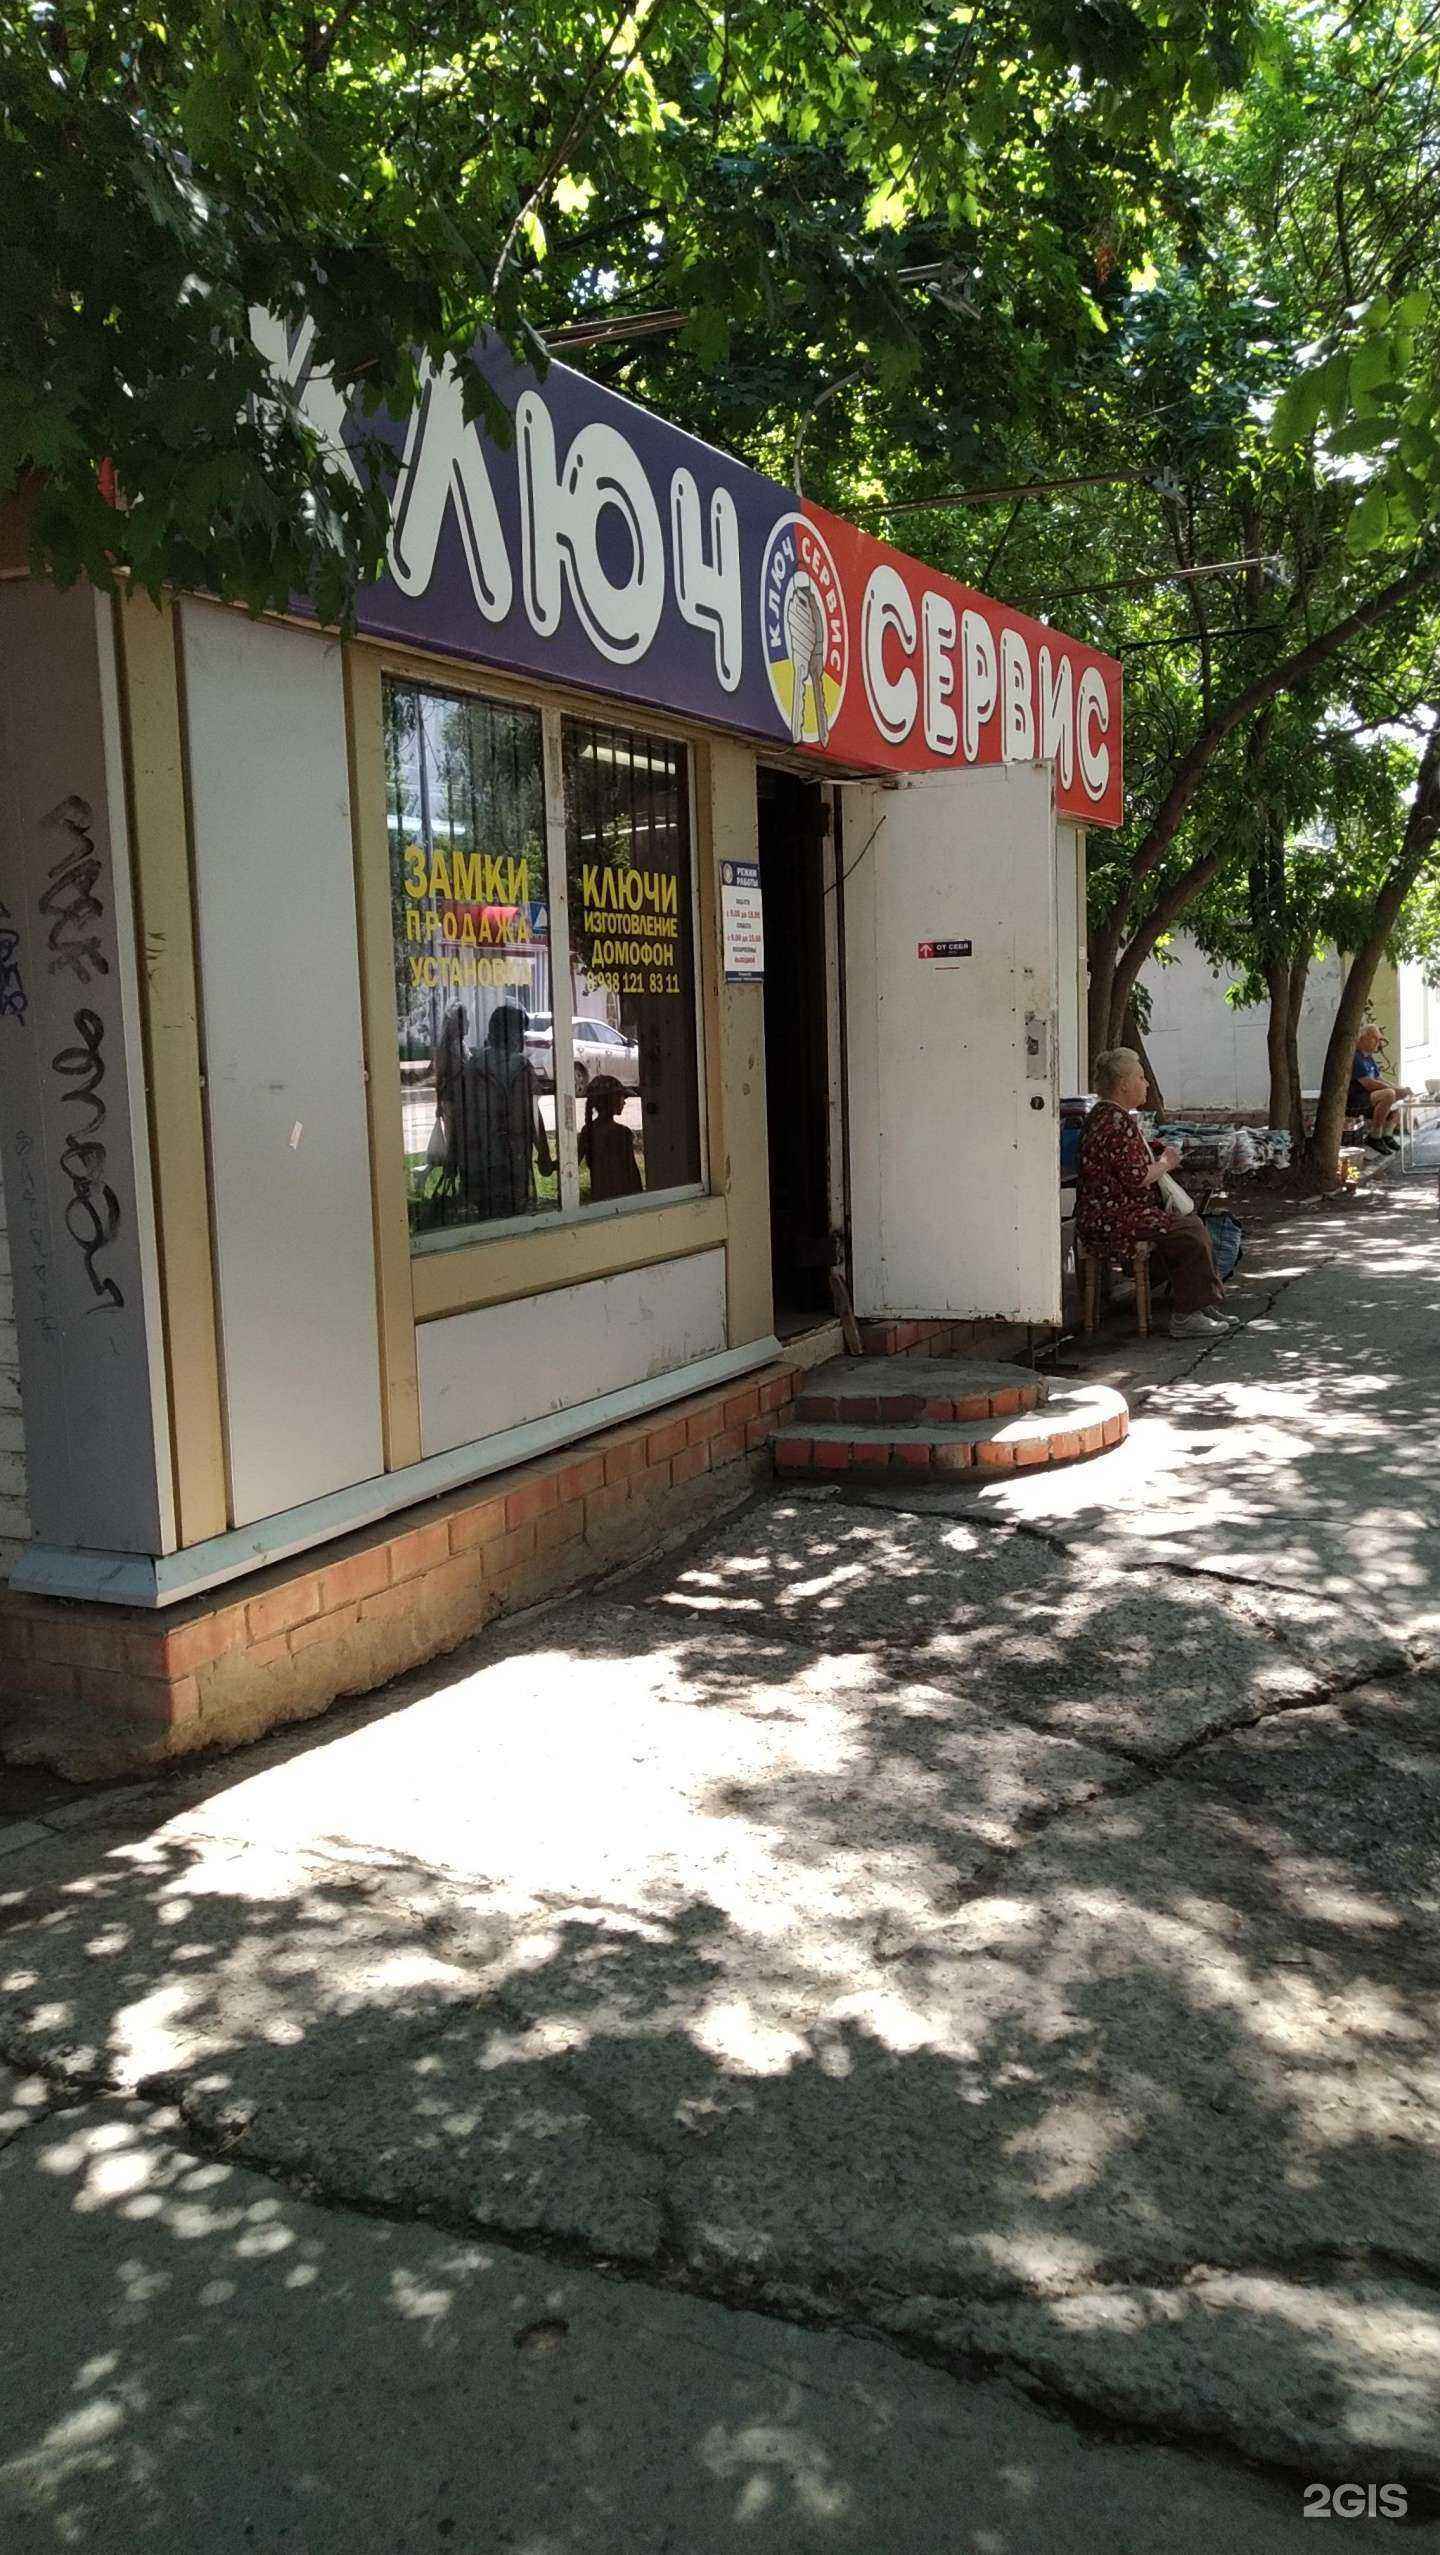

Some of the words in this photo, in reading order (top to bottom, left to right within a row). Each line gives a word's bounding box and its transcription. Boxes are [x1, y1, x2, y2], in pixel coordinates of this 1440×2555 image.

[767, 536, 796, 648] КЛЮЧ
[801, 537, 842, 672] СЕРВИС
[861, 565, 1109, 801] СЕРВИС
[404, 845, 529, 903] ЗАМКИ
[583, 864, 677, 914] КЛЮЧИ
[406, 909, 531, 948] ПРОДАЖА
[584, 910, 678, 938] ИЗГОТОВЛЕНИЕ
[592, 939, 673, 969] ДОМОФОН
[623, 973, 644, 993] 121
[649, 973, 663, 993] 83
[665, 973, 680, 993] 11
